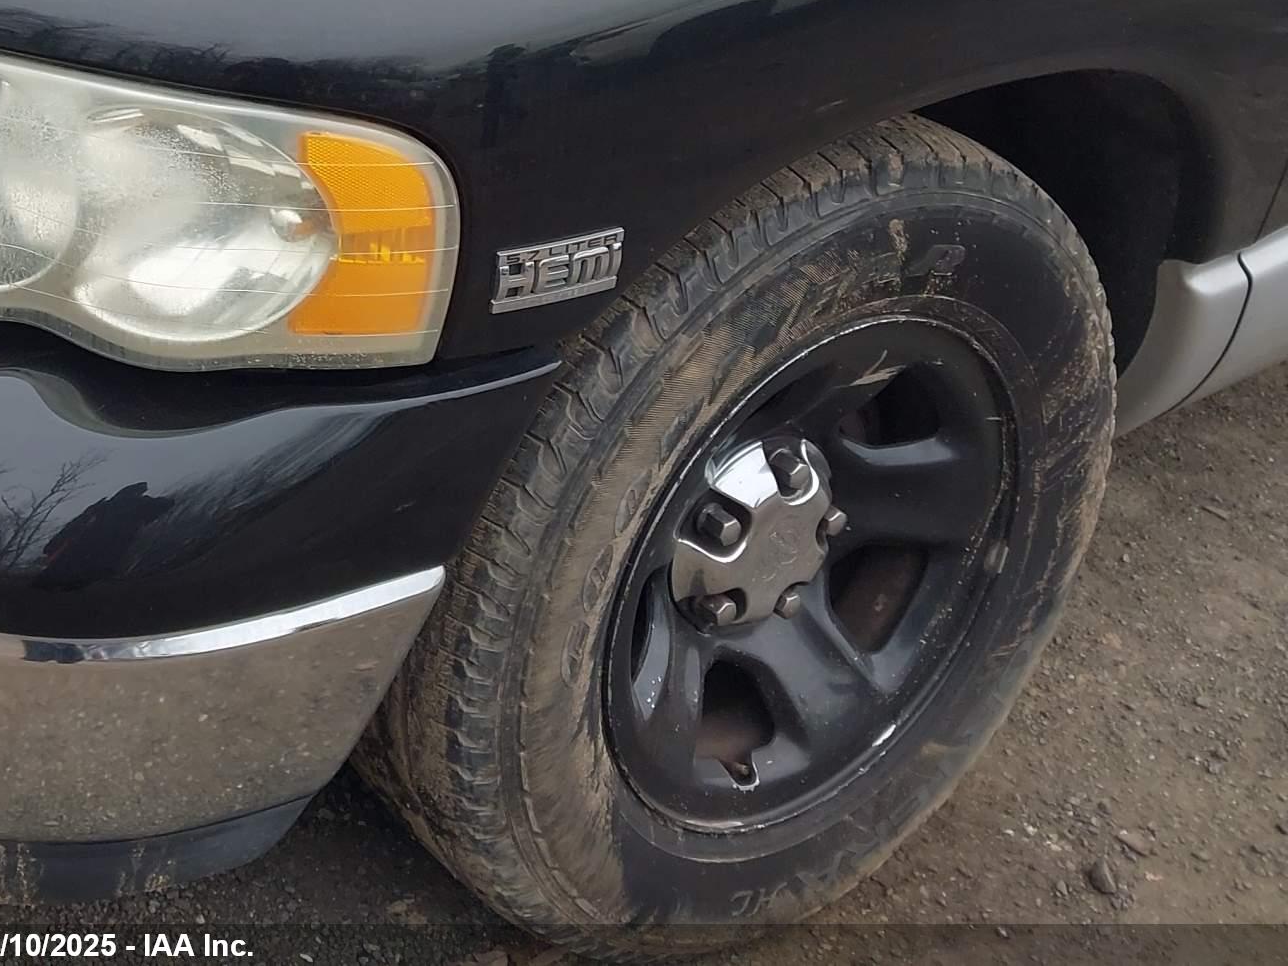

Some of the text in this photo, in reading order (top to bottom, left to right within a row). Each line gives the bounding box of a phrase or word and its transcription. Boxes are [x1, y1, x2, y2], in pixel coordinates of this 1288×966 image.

[495, 241, 623, 302] HEMI
[506, 235, 618, 265] 5.7 LITER
